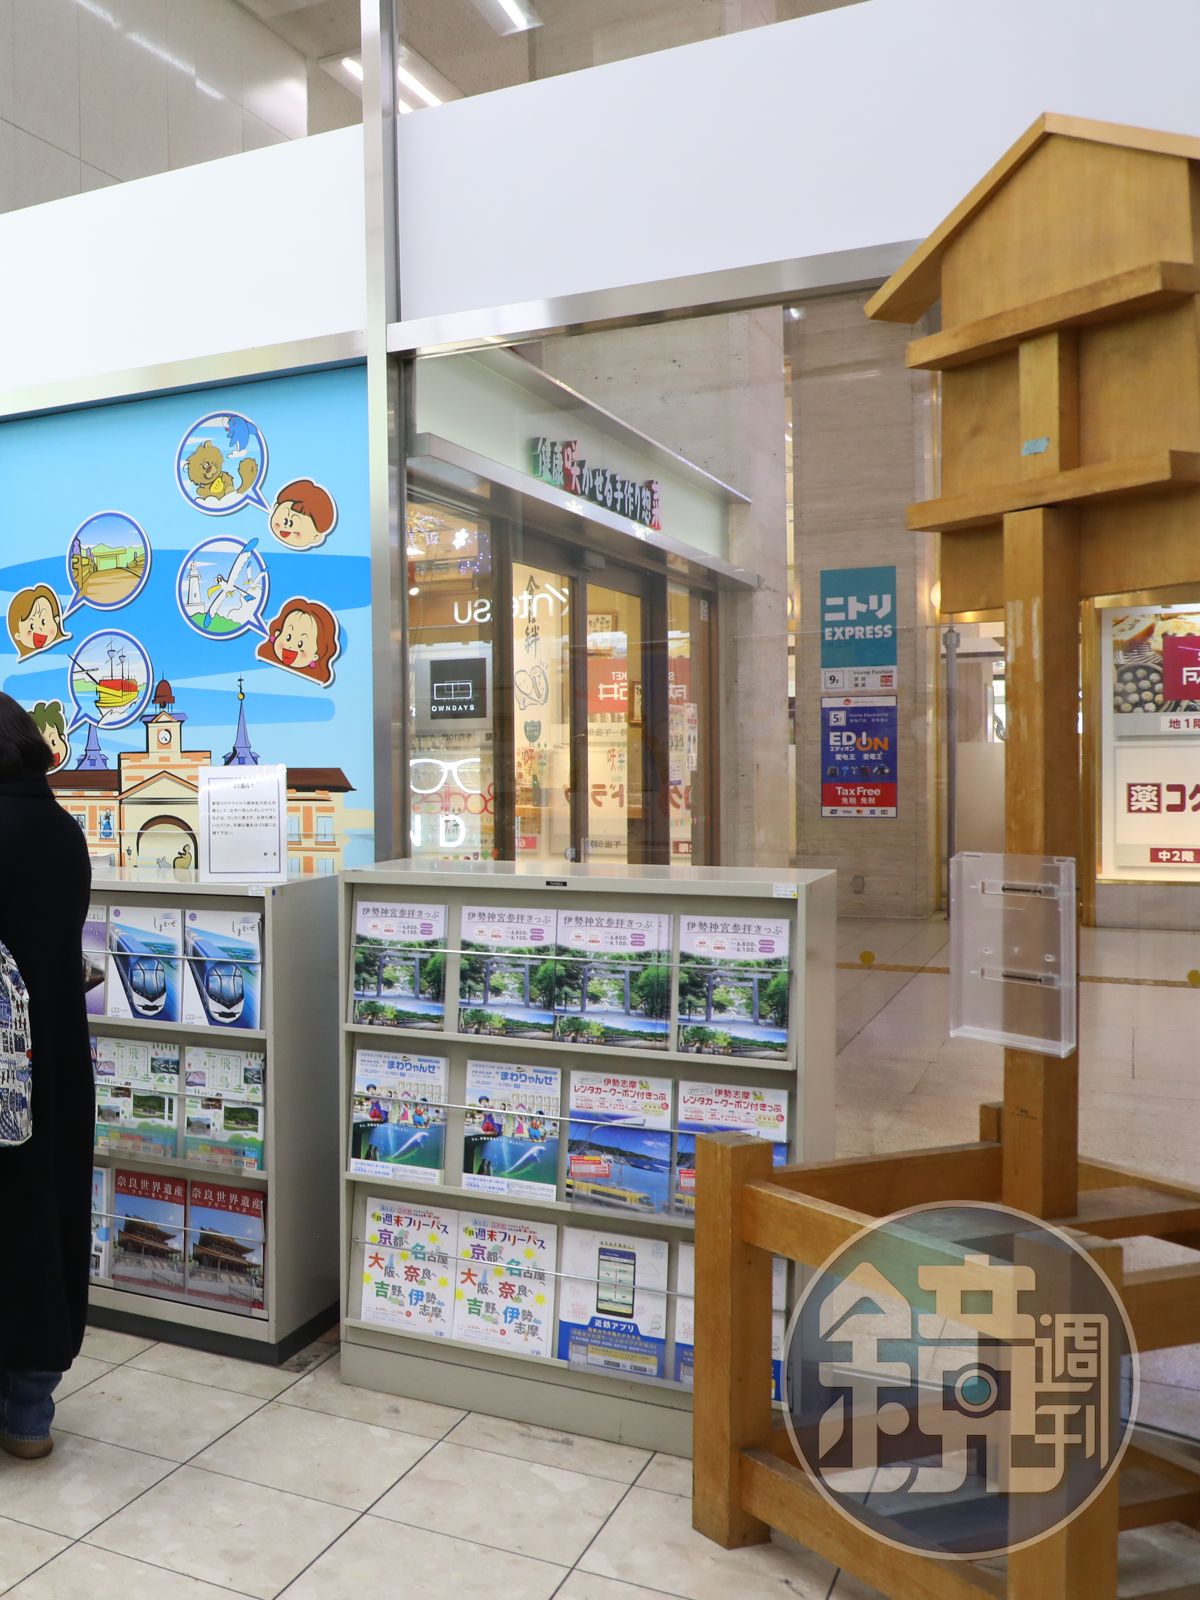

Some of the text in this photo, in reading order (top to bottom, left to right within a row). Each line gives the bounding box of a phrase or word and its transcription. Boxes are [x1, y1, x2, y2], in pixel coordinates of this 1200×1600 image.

[825, 594, 892, 621] ニトリ
[825, 624, 892, 640] EXPRESS
[431, 704, 475, 712] OWNDAYS
[829, 731, 889, 752] EDION
[836, 786, 881, 796] Tax Free
[1158, 850, 1195, 862] 中2階
[362, 907, 440, 920] 伊勢神宮参拝きっぷ
[467, 911, 551, 924] 伊勢神宮参拝きっぷ
[564, 915, 653, 929] 伊勢神宮参拝きっぷ
[687, 921, 783, 935] 伊勢神宮参拝きっぷ
[387, 1060, 437, 1074] まわりゃんせ
[500, 1071, 553, 1085] まわりゃんせ
[603, 1078, 637, 1089] 伊勢志摩
[574, 1085, 667, 1101] レンタカークーポン付きっぷ
[714, 1088, 751, 1100] 伊勢志摩
[683, 1095, 782, 1113] レンタカークーポン付きっぷ
[116, 1175, 184, 1198] 奈良世界遺産
[191, 1187, 262, 1209] 奈良世界遺産
[383, 1213, 449, 1235] 週末フリーパス
[475, 1227, 546, 1250] 週末フリーパス
[595, 1319, 634, 1333] 近鉄アプリ
